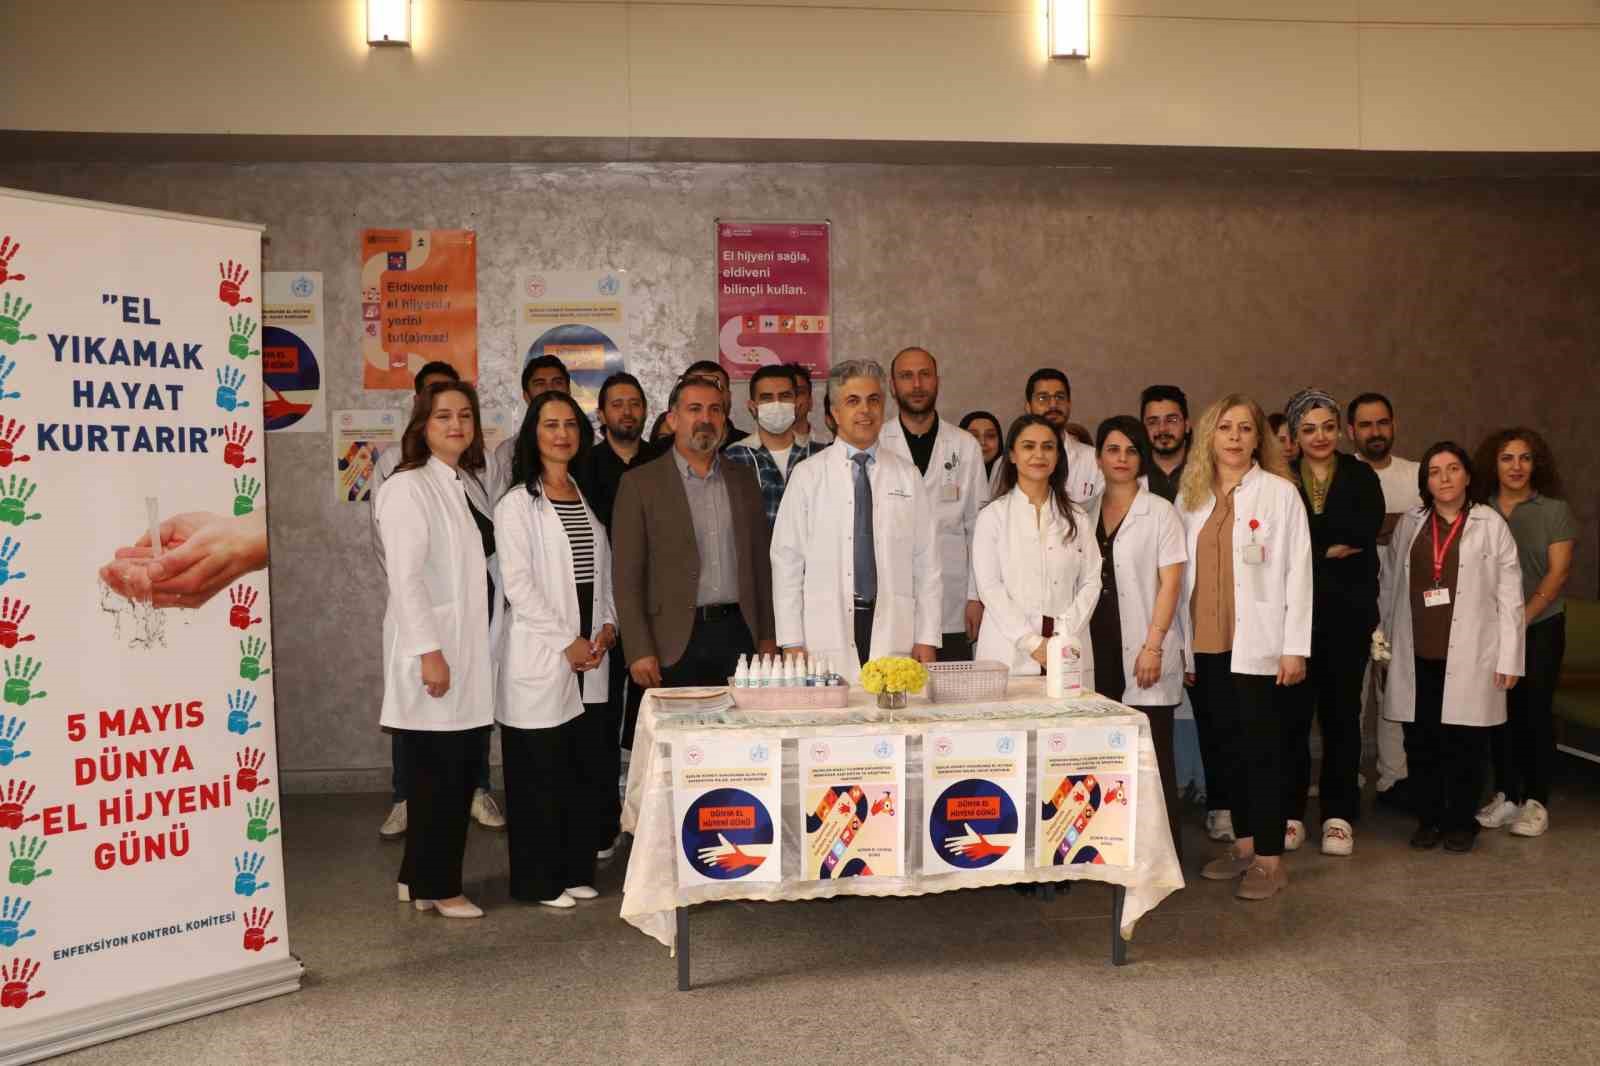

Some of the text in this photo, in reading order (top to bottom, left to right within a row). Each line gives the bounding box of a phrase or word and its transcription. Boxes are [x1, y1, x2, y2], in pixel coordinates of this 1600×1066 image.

[722, 267, 771, 278] eldiveni
[736, 250, 774, 263] hijyeni
[386, 281, 448, 292] Eldivenler
[723, 283, 807, 296] bilinçli kullan.
[387, 315, 422, 328] yerini
[48, 334, 204, 370] YIKAMAK
[73, 380, 184, 411] HAYAT
[67, 701, 205, 742] 5 MAYIS
[75, 744, 194, 786] DÜNYA
[42, 775, 232, 836] EL HİJYENİ
[95, 823, 190, 870] GÜNÜ
[53, 911, 236, 960] ENFEKSİYON KONTROL KOMİTESİ
